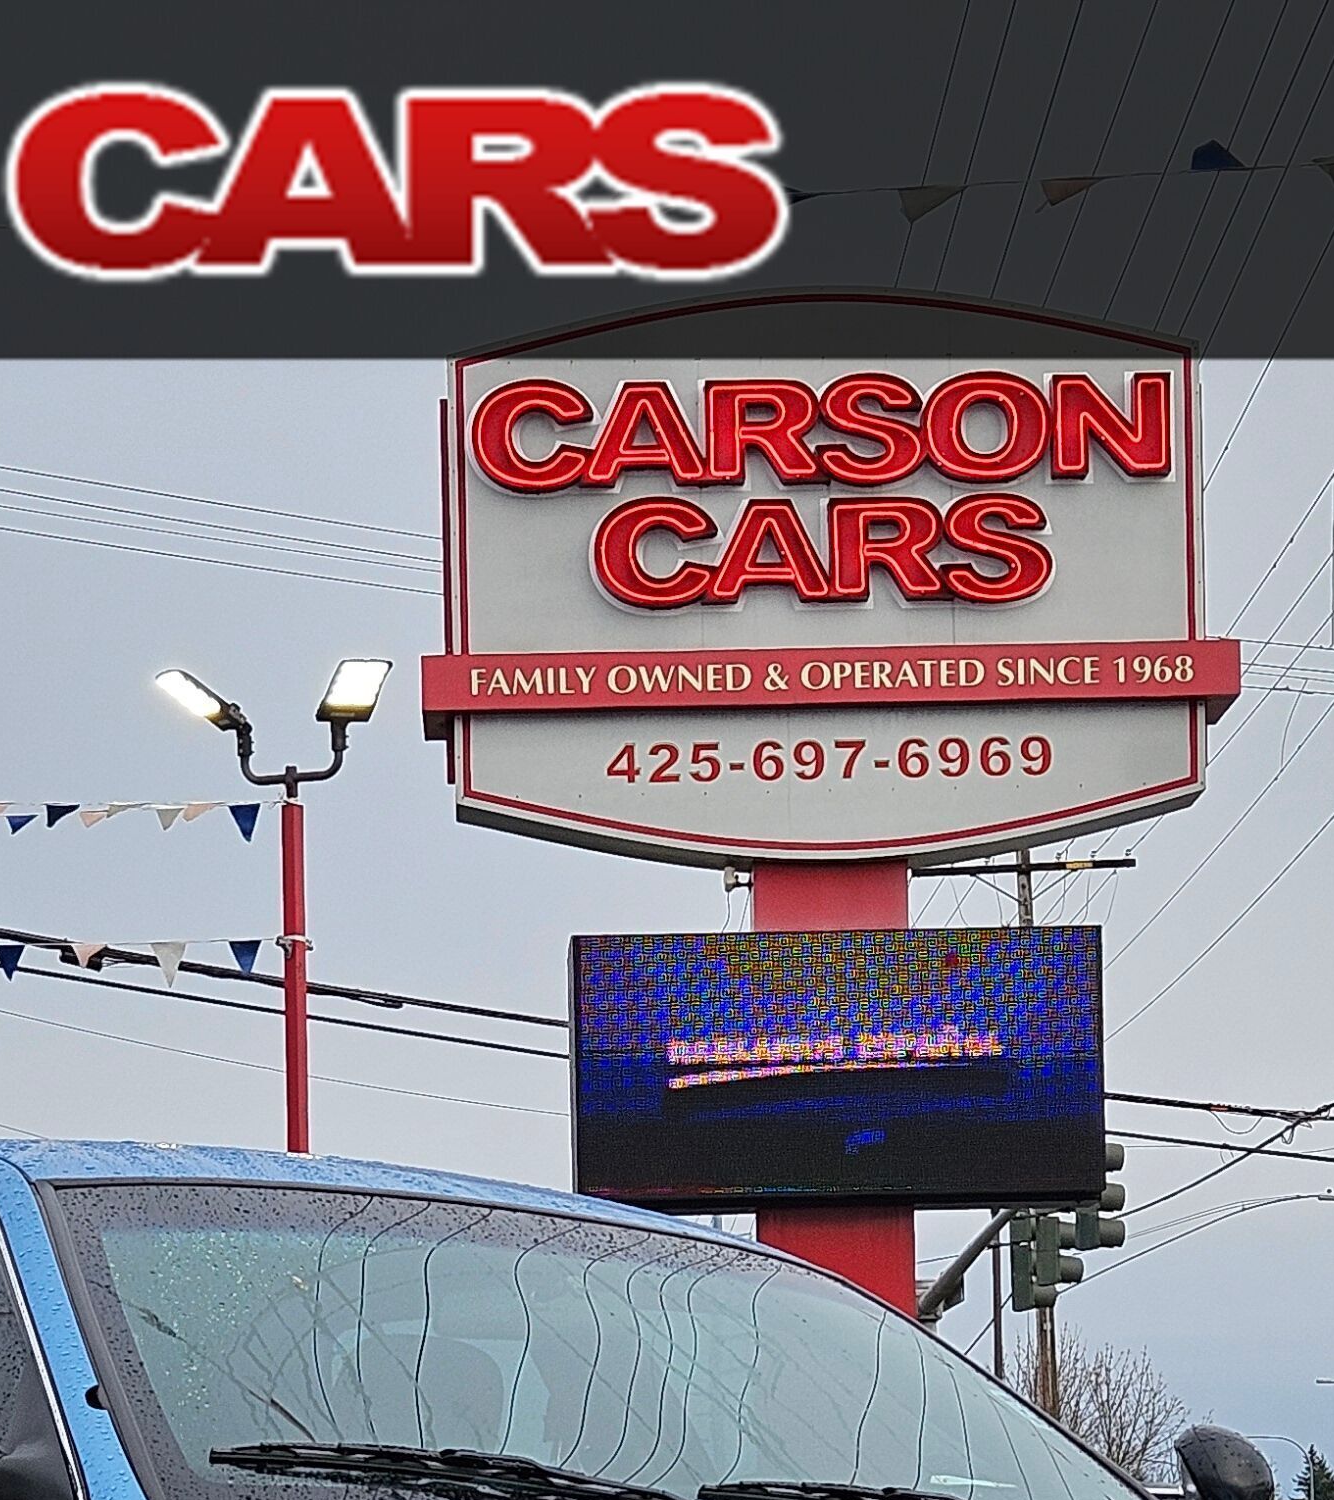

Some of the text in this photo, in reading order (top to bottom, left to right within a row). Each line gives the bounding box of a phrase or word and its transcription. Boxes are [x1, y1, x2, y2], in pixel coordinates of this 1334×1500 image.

[470, 371, 1172, 492] CARSON
[593, 493, 1053, 607] CARS
[470, 655, 1195, 696] FAMILY OWNED & OPERATED SINCE 1968
[606, 735, 1053, 784] 425-697-6969
